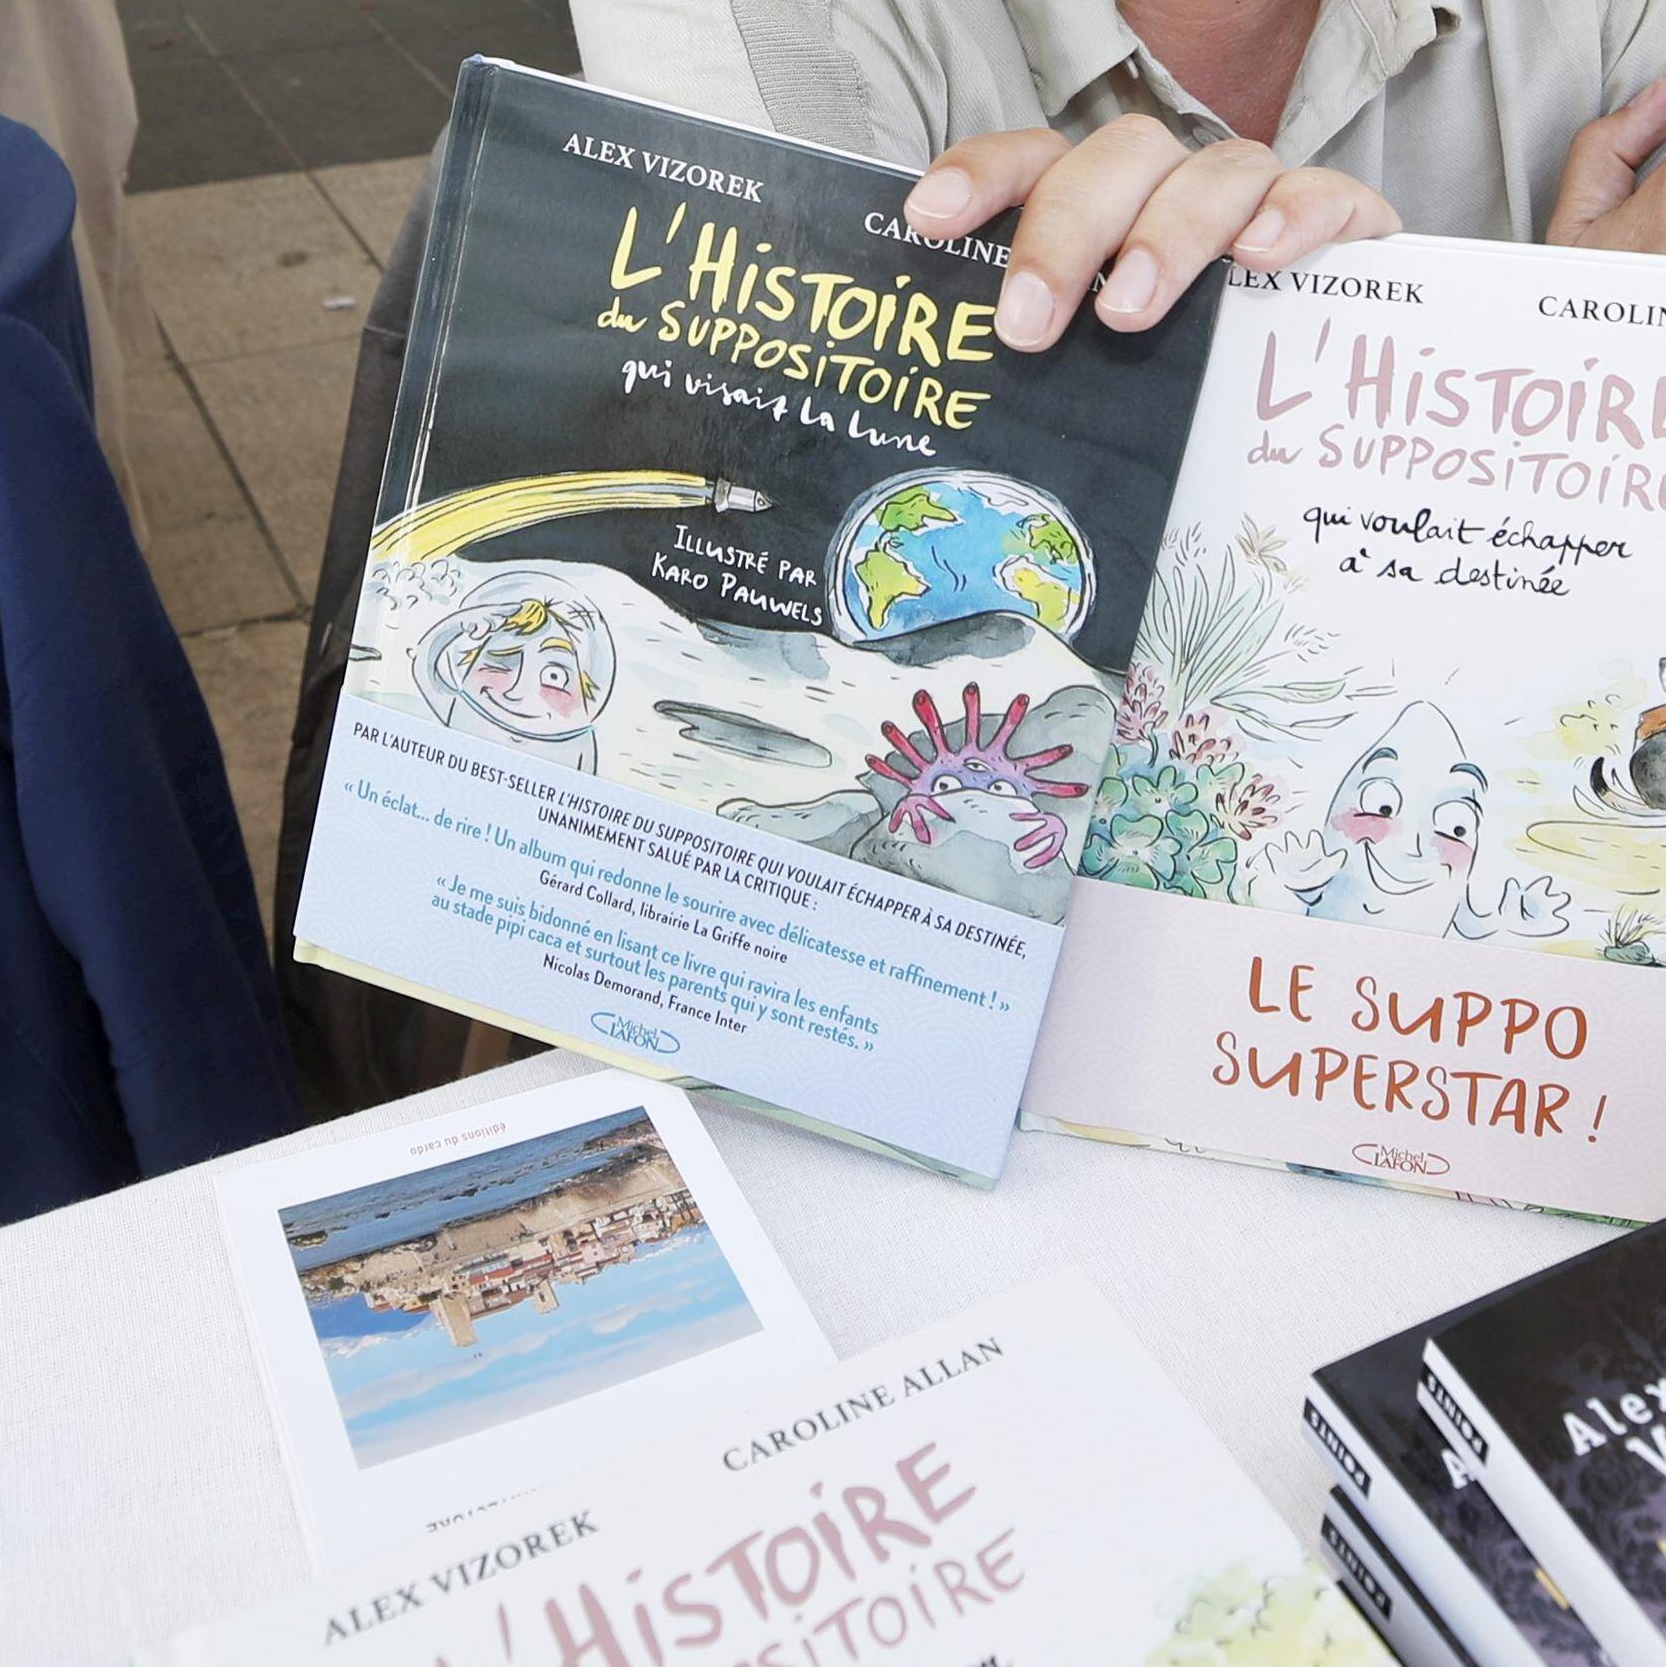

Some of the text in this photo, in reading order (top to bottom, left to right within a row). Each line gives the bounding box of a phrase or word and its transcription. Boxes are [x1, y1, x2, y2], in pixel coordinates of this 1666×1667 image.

[563, 133, 764, 203] ALEX VIZOREK
[595, 296, 649, 333] du
[1228, 268, 1423, 304] LEX VIZOREK
[622, 360, 937, 456] qui visait la lune
[1247, 430, 1304, 464] du
[674, 524, 817, 587] ILLUSTRÉ PAR
[1303, 507, 1632, 560] qui voulait échapper
[1339, 548, 1570, 596] à sa destinée
[652, 552, 823, 626] KARO PAUWELS
[354, 722, 1025, 959] PAR L'AUTEUR DU BEST-SELLER L'HISTOIRE DU SUPPOSITOIRE QUI VOULAIT ÉCHAPPER À SA DESTINÉE,
[539, 807, 811, 907] UNANIMEMENT SALUÉ PAR LA CRITIQUE
[357, 779, 379, 804] Un
[433, 807, 453, 829] de
[456, 817, 481, 838] rire
[494, 826, 516, 851] Un
[519, 838, 566, 867] album
[570, 860, 596, 877] qui
[598, 868, 661, 897] redonne
[664, 882, 680, 904] le
[683, 896, 736, 922] sourire
[739, 915, 774, 935] avec
[779, 922, 865, 966] délicatesse
[868, 958, 886, 975] et
[889, 964, 986, 1006] raffinement
[540, 870, 787, 963] Gérard Collard, librairie La Griffe noire
[431, 895, 858, 1049] au stade pipi caca et surtout les parents qui y sont restés.
[447, 874, 878, 1034] Je me suis bidonné en lisant ce livre qui ravira les enfants
[544, 953, 747, 1033] Nicolas Demorand, France Inter
[609, 1030, 659, 1052] LAFON
[615, 1013, 657, 1039] Michel
[1249, 956, 1588, 1060] LE SUPPO
[1213, 1031, 1570, 1137] SUPERSTAR
[1369, 1156, 1425, 1177] LAFON
[1379, 1144, 1435, 1167] Michel
[723, 1337, 1003, 1471] CAROLINE ALLAN
[1425, 1373, 1482, 1455] POINTS
[1311, 1408, 1365, 1486] POINTS
[327, 1511, 599, 1643] ALEX VIZOREK
[1329, 1528, 1385, 1606] POINTS
